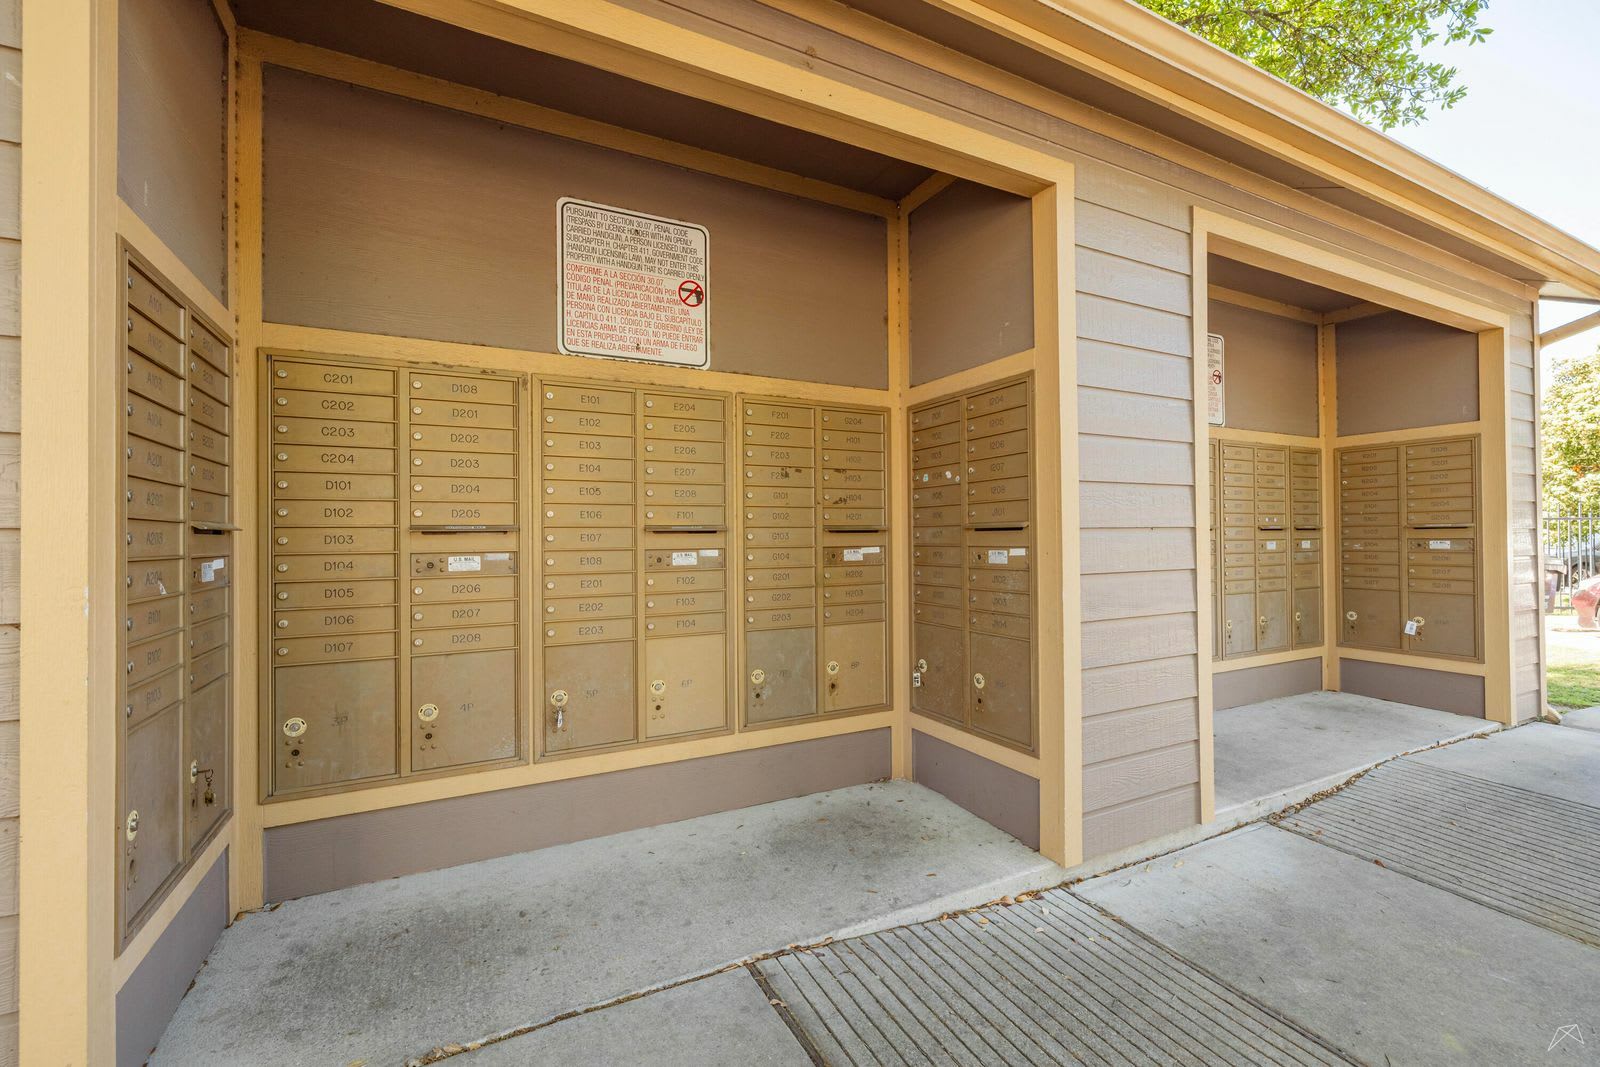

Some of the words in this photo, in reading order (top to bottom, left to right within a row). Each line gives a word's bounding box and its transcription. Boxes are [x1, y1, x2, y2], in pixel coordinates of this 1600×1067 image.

[566, 206, 598, 220] PURSUANT
[600, 214, 608, 222] TO
[610, 216, 634, 227] SECTION
[654, 224, 672, 234] PENAL
[673, 228, 688, 238] CODE
[566, 215, 596, 228] (TRESPASS
[605, 223, 626, 234] LICENSE
[650, 232, 664, 241] WITH
[673, 236, 692, 246] OPENLY
[566, 224, 591, 236] CARRIED
[630, 237, 651, 247] PERSON
[653, 241, 678, 252] LICENSED
[680, 246, 697, 256] UNDER
[566, 233, 604, 248] SUBCHAPTER
[613, 242, 638, 254] CHAPTER
[652, 250, 688, 263] GOVERNMENT
[689, 256, 703, 265] CODE
[598, 249, 628, 261] LICENSING
[645, 257, 656, 266] MAY
[658, 260, 668, 268] NOT
[670, 261, 686, 271] ENTER
[688, 264, 699, 273] THIS
[566, 251, 596, 263] PROPERTY
[596, 257, 610, 266] WITH
[617, 260, 643, 271] HANDGUN
[644, 265, 656, 274] THAT
[664, 268, 685, 278] CARRIED
[686, 272, 704, 281] OPENLY
[566, 263, 602, 276] CONFORME
[593, 277, 612, 287] PENAL
[665, 288, 676, 297] POR
[567, 282, 592, 293] TITULAR
[593, 286, 602, 294] DE
[612, 289, 638, 299] LICENCIA
[640, 293, 652, 301] CON
[666, 297, 682, 306] ARMA
[566, 291, 575, 300] DE
[576, 293, 595, 302] MANO
[597, 296, 630, 307] REALIZADO
[679, 308, 690, 316] UNA
[566, 300, 596, 312] PERSONA
[597, 305, 610, 314] CON
[612, 307, 638, 318] LICENCIA
[640, 311, 654, 320] BAJO
[566, 319, 598, 330] LICENCIAS
[600, 323, 617, 333] ARMA
[619, 326, 627, 334] DE
[652, 330, 660, 338] NO
[662, 331, 680, 341] PUEDE
[682, 334, 703, 344] ENTRAR
[644, 320, 652, 328] DE
[654, 322, 682, 332] GOBIERNO
[696, 327, 704, 336] DE
[566, 328, 575, 337] EN
[576, 329, 592, 339] ESTA
[594, 332, 627, 343] PROPIEDAD
[629, 336, 641, 345] CON
[642, 338, 652, 346] UN
[652, 339, 669, 348] ARMA
[680, 342, 697, 351] FUEGO
[566, 337, 580, 347] QUE
[581, 339, 590, 348] SE
[592, 340, 616, 351] REALIZA
[324, 373, 353, 384] C201
[452, 384, 478, 393] D108
[581, 395, 599, 404] E101
[321, 400, 354, 410] C202
[674, 403, 695, 411] E204
[452, 409, 478, 418] D201
[772, 411, 789, 419] F201
[580, 418, 600, 427] E102
[321, 427, 354, 437] C203
[674, 424, 696, 433] E205
[451, 434, 479, 443] D202
[580, 441, 601, 449] E103
[674, 446, 696, 455] E206
[321, 454, 354, 463] C204
[451, 459, 479, 468] D203
[579, 464, 600, 472] E104
[674, 468, 696, 476] E207
[326, 481, 351, 490] D101
[452, 484, 480, 493] D204
[580, 488, 601, 496] E105
[325, 508, 353, 517] D102
[452, 510, 480, 518] D205
[580, 511, 602, 519] E106
[325, 535, 353, 544] D103
[580, 534, 602, 542] E107
[580, 557, 602, 565] E108
[325, 562, 353, 571] D104
[580, 580, 602, 588] E201
[676, 576, 695, 585] F102
[325, 589, 353, 598] D105
[452, 584, 480, 594] D206
[676, 598, 695, 607] F103
[579, 603, 603, 612] E202
[452, 609, 480, 619] D207
[325, 616, 354, 625] D106
[676, 620, 696, 628] F104
[579, 626, 603, 636] E203
[452, 634, 480, 644] D208
[325, 642, 353, 653] D107
